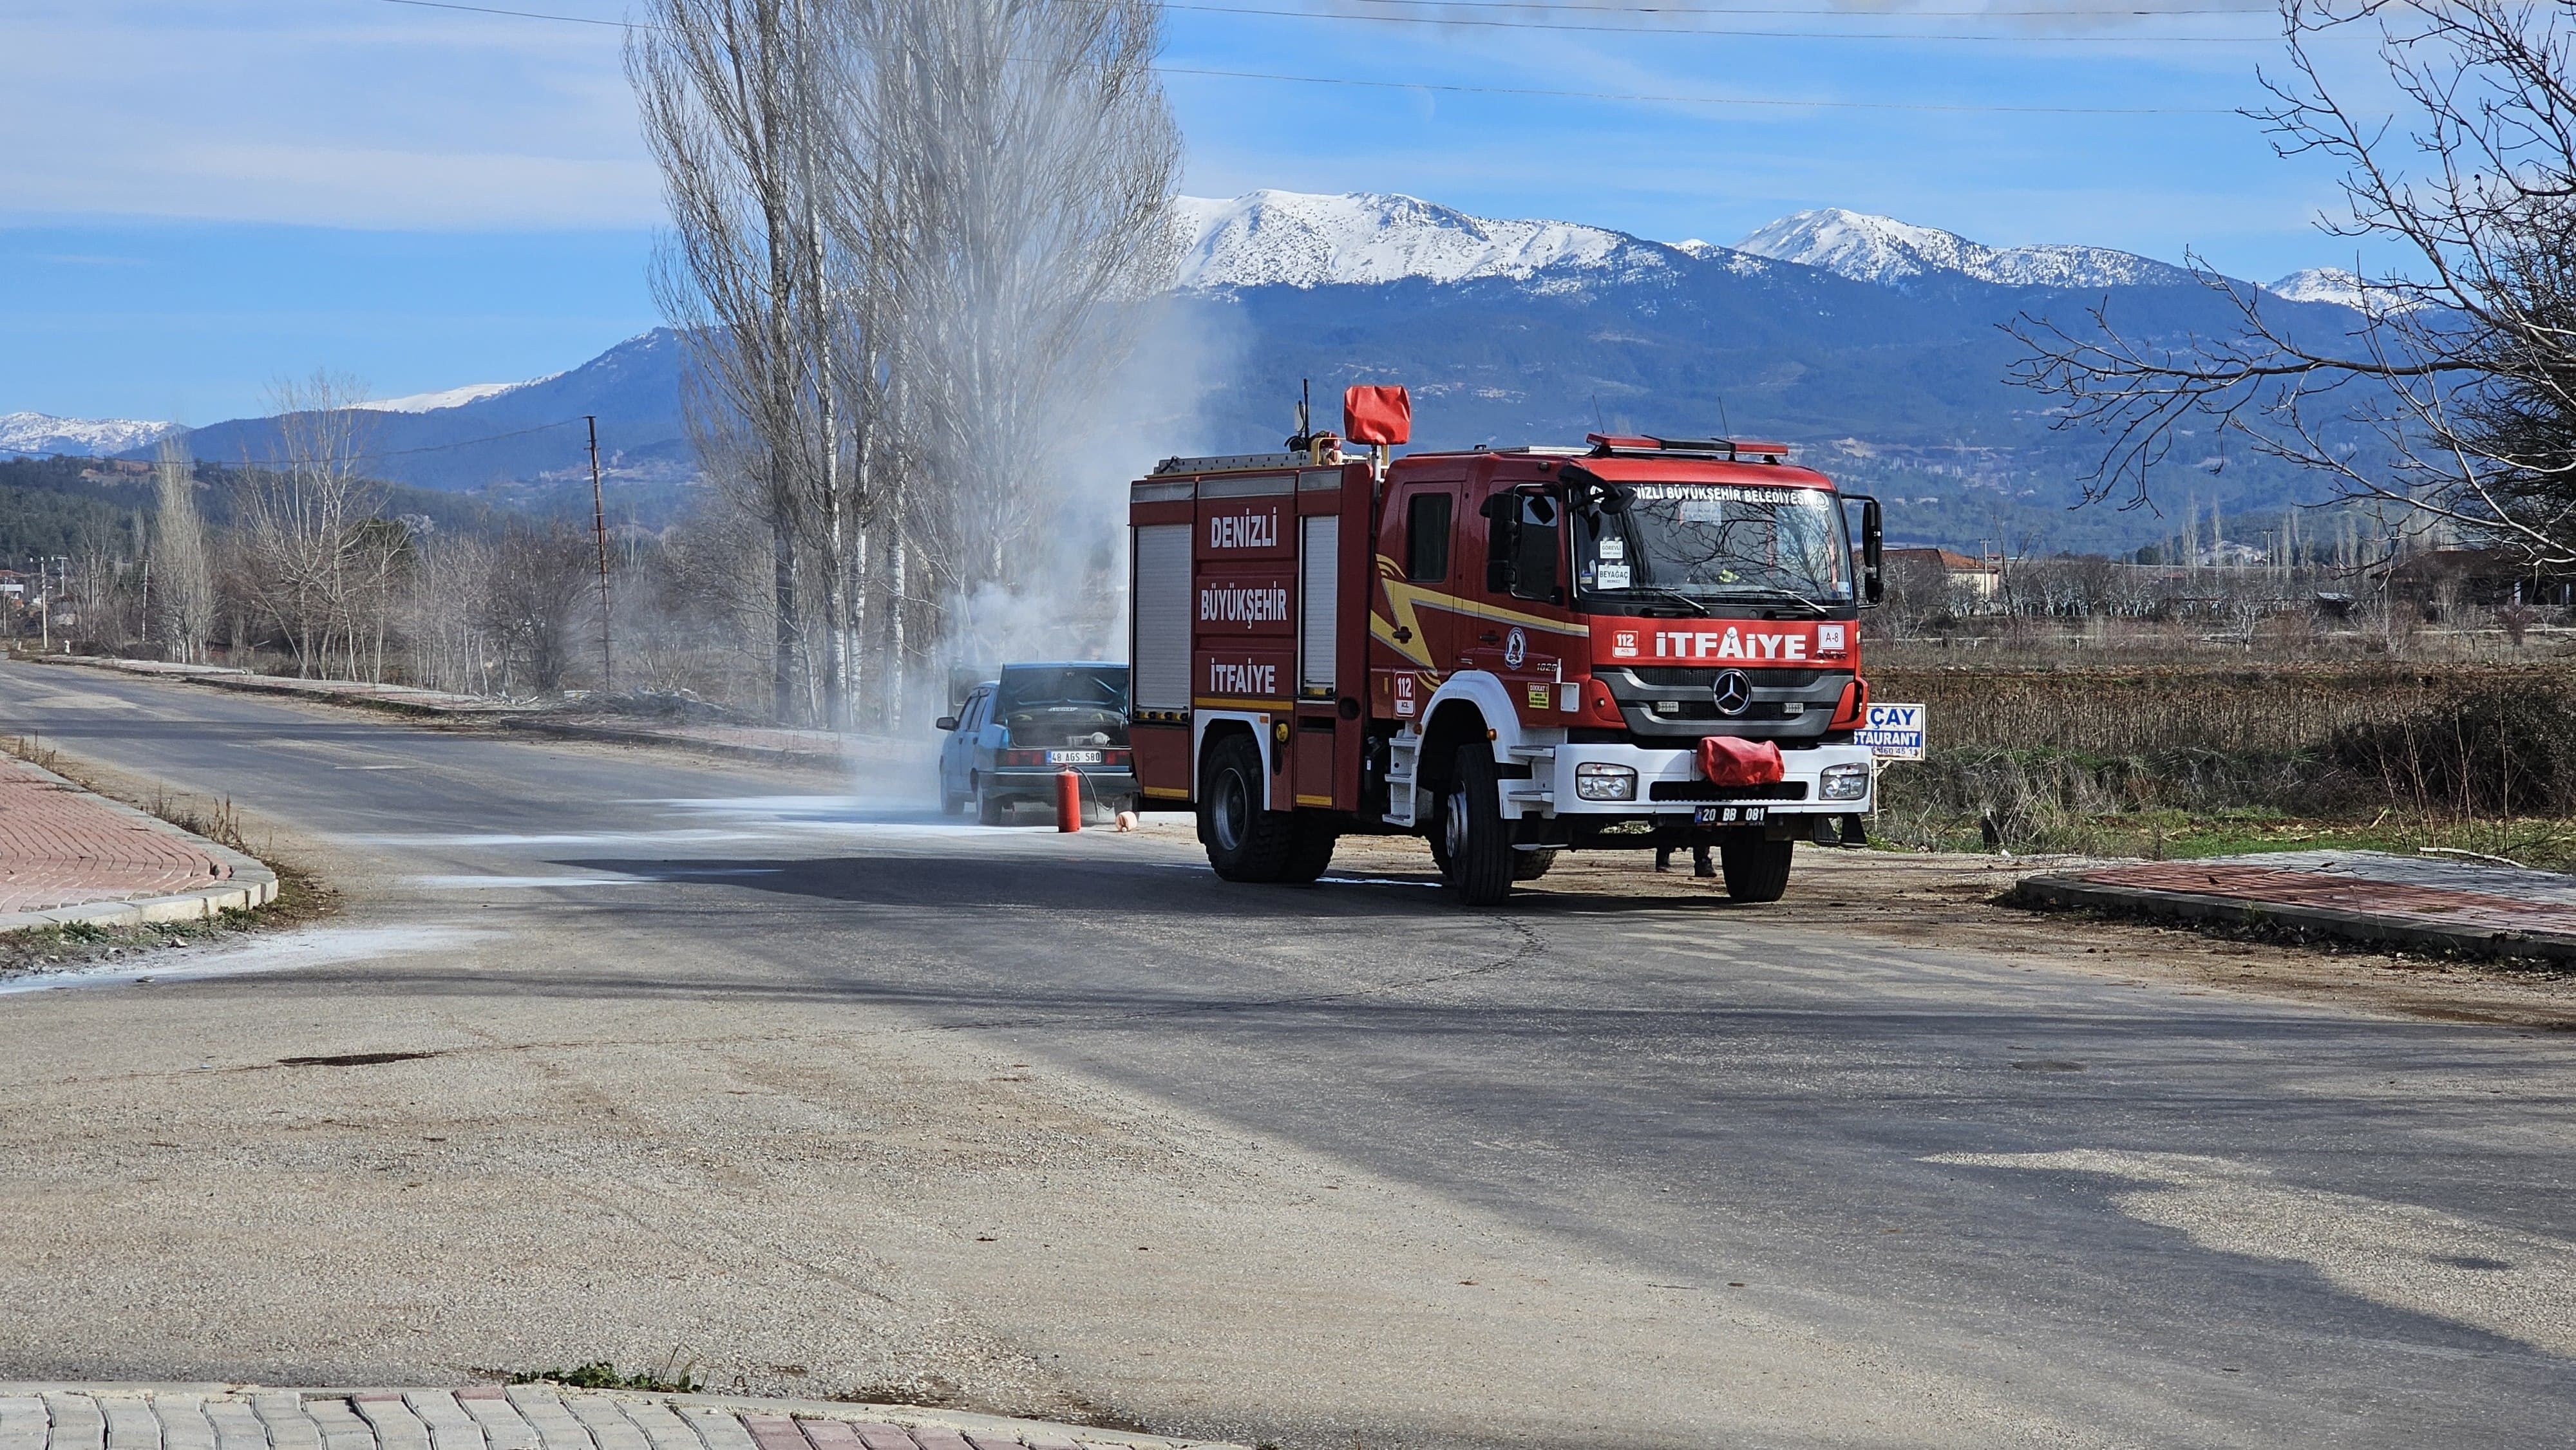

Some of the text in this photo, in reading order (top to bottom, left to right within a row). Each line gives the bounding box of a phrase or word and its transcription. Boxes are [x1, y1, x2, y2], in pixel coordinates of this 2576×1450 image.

[1632, 484, 1664, 500] NİZLİ
[1667, 484, 1741, 503] BÜYÜKŞEHİR
[1211, 507, 1277, 548] DENİZLİ
[1600, 570, 1629, 579] BEYAĞAÇ
[1201, 581, 1287, 629] BÜYÜKŞEHİR
[1616, 634, 1634, 647] 112
[1825, 632, 1839, 643] A-8
[1211, 657, 1275, 693] İTFAİYE
[1397, 677, 1412, 697] 112
[1854, 731, 1918, 746] STAURANT
[1052, 752, 1100, 762] 48 AGS 580
[1703, 808, 1765, 822] 20 BB 081
